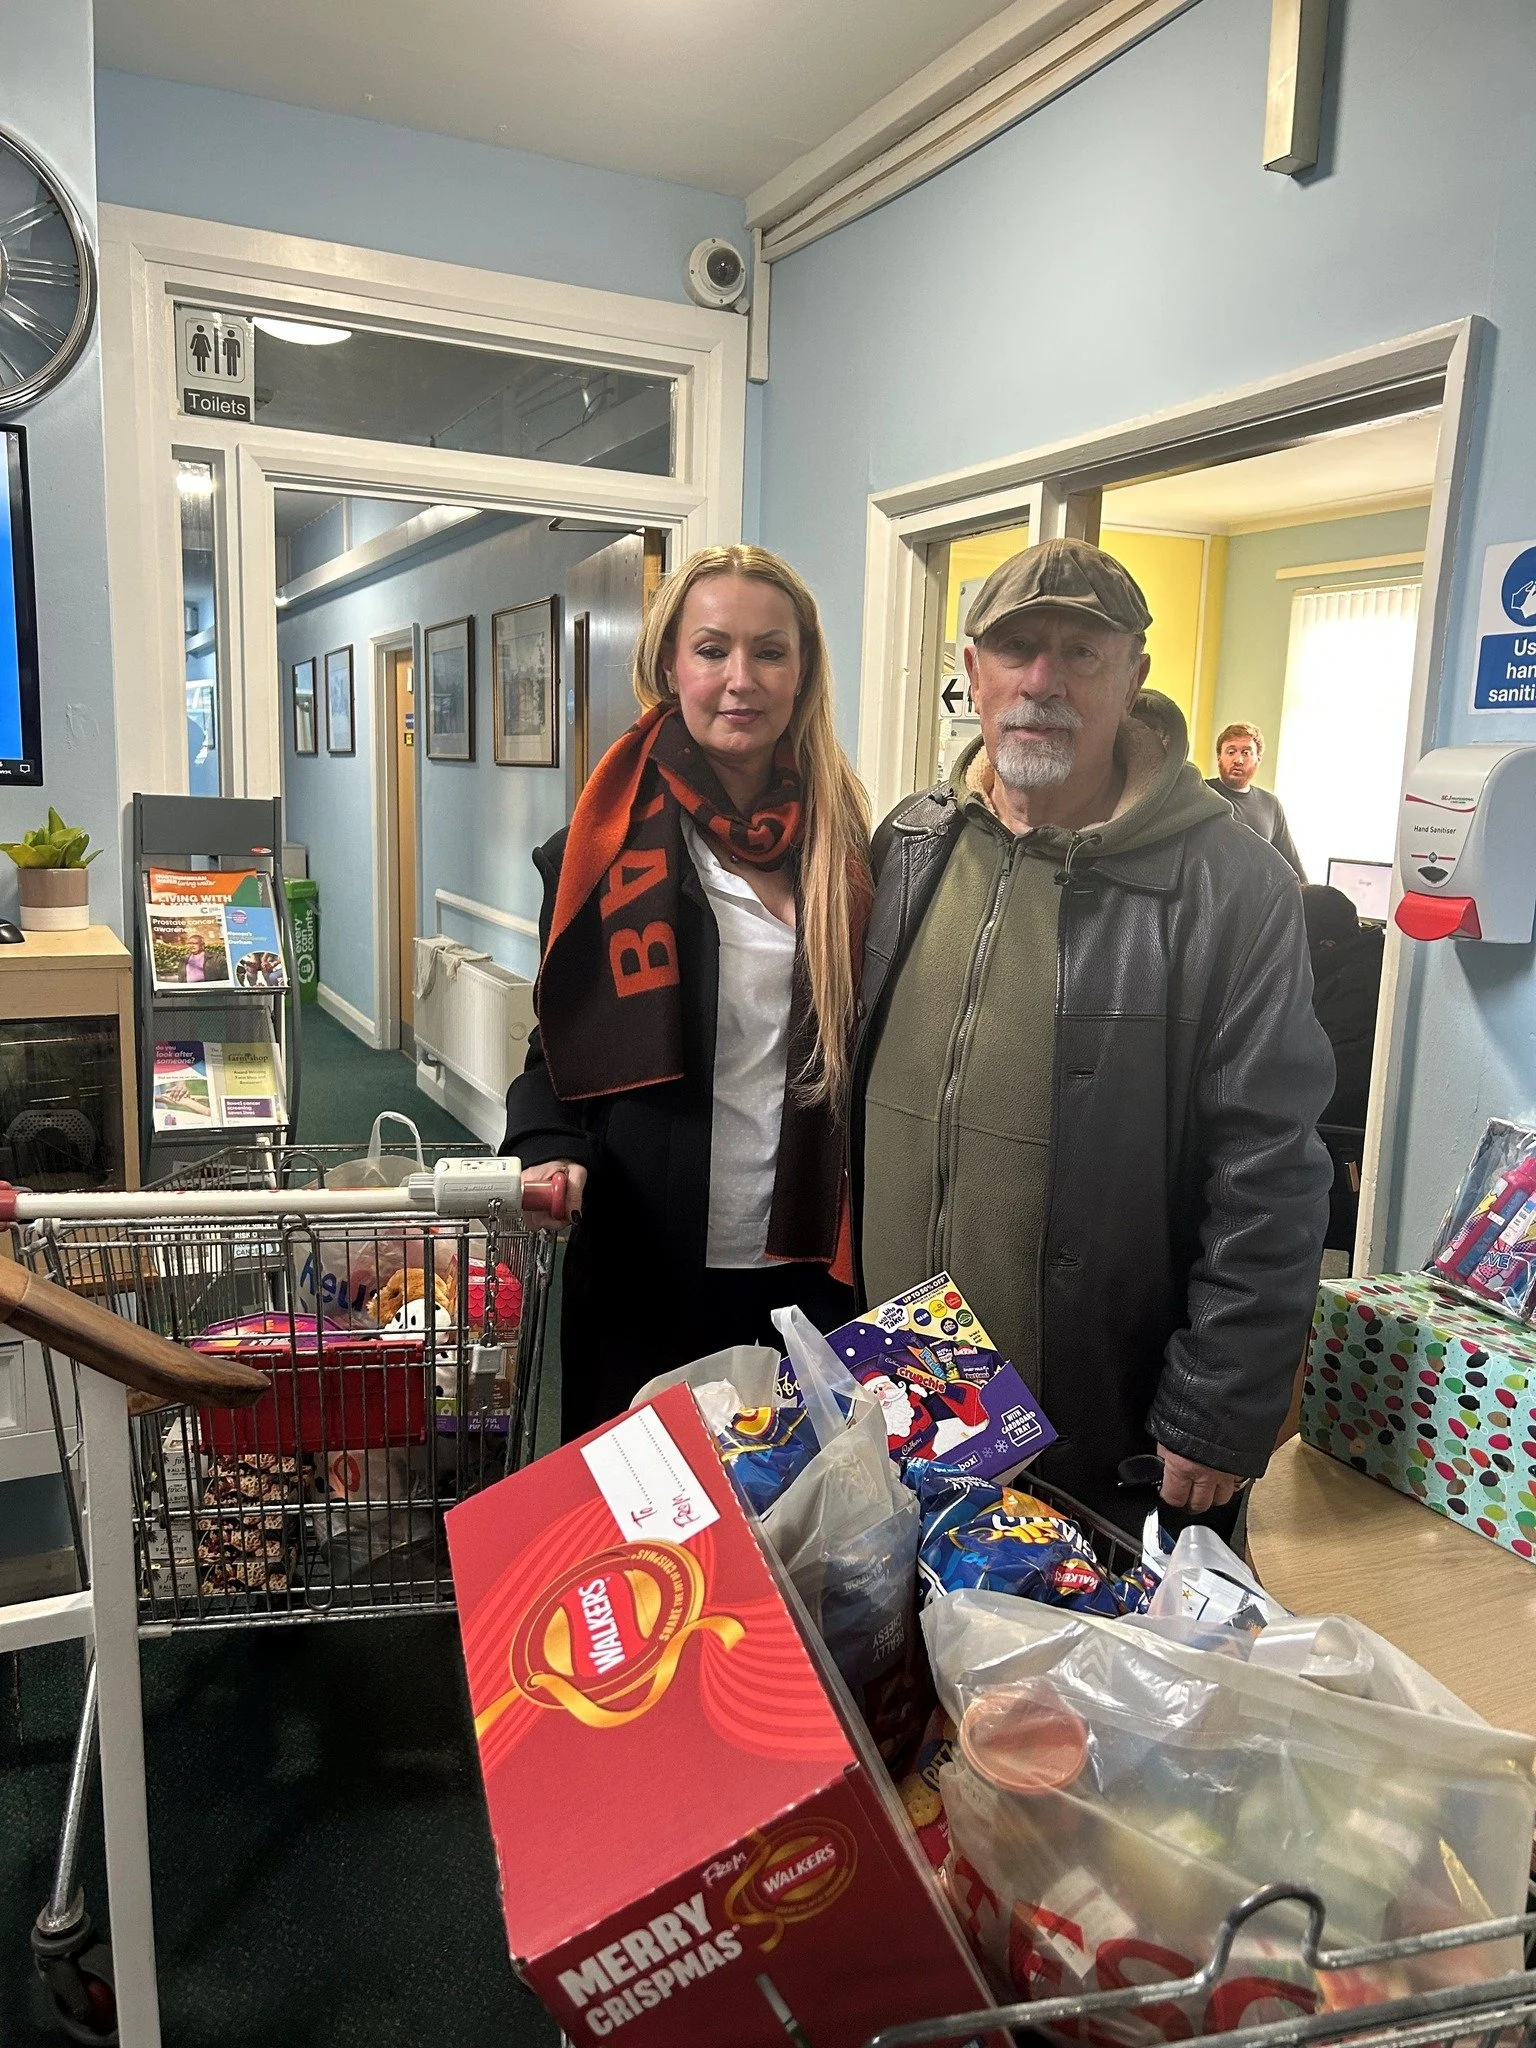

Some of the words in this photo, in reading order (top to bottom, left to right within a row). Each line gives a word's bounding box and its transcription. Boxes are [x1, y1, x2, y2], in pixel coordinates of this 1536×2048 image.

[188, 392, 246, 416] Toilets
[1488, 684, 1536, 702] saniti
[1413, 825, 1429, 833] Hand
[1429, 826, 1457, 835] Sanitiser
[158, 894, 199, 903] LIVING
[200, 894, 232, 903] WITH
[152, 918, 187, 926] Prostate
[305, 909, 314, 952] counts
[294, 918, 303, 954] every
[156, 1057, 196, 1065] someone?
[902, 1294, 913, 1304] UP
[911, 1290, 921, 1300] TO
[920, 1283, 934, 1295] 50%
[882, 1306, 896, 1316] Who
[898, 1366, 946, 1393] crunchie
[1001, 1410, 1037, 1435] CARDBOARD
[1006, 1409, 1023, 1422] WITH
[1013, 1422, 1032, 1436] TRAY
[901, 1437, 923, 1456] Cadbury
[957, 1454, 979, 1471] box!
[1054, 1569, 1099, 1591] WALKERS
[577, 1577, 626, 1675] WALKERS
[658, 1606, 684, 1642] SHARE
[871, 1611, 903, 1649] CHEESY
[761, 1843, 836, 1895] WALKERS
[557, 1891, 712, 2008] MERRY
[585, 1926, 743, 2038] CRISPMAS
